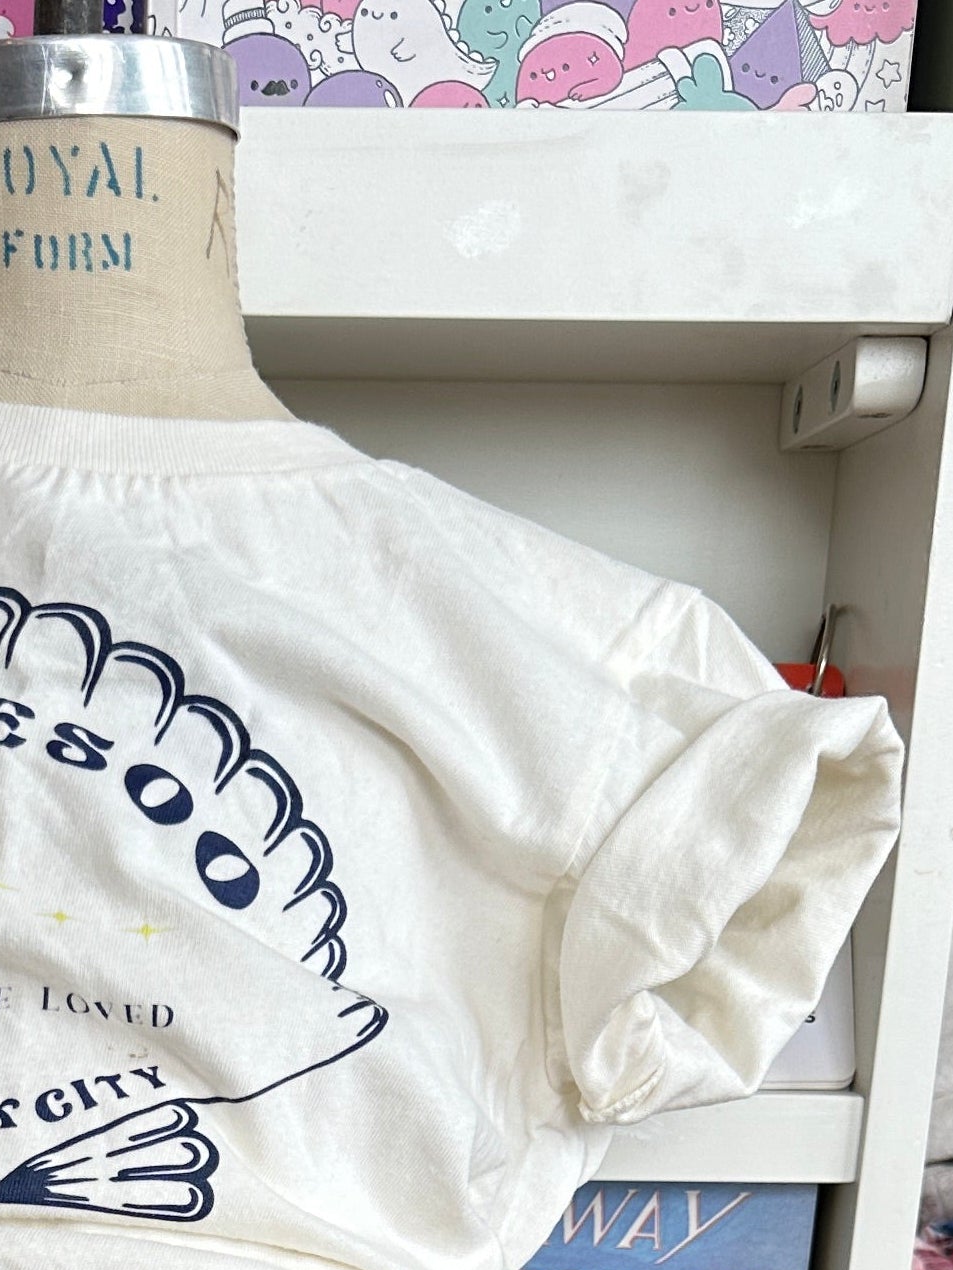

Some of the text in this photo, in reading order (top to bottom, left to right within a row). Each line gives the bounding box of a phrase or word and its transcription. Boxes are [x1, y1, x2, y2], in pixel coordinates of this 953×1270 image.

[2, 229, 132, 272] FORM
[42, 986, 176, 1030] LOVED
[35, 1065, 169, 1124] CITY
[542, 1187, 752, 1265] WAY
